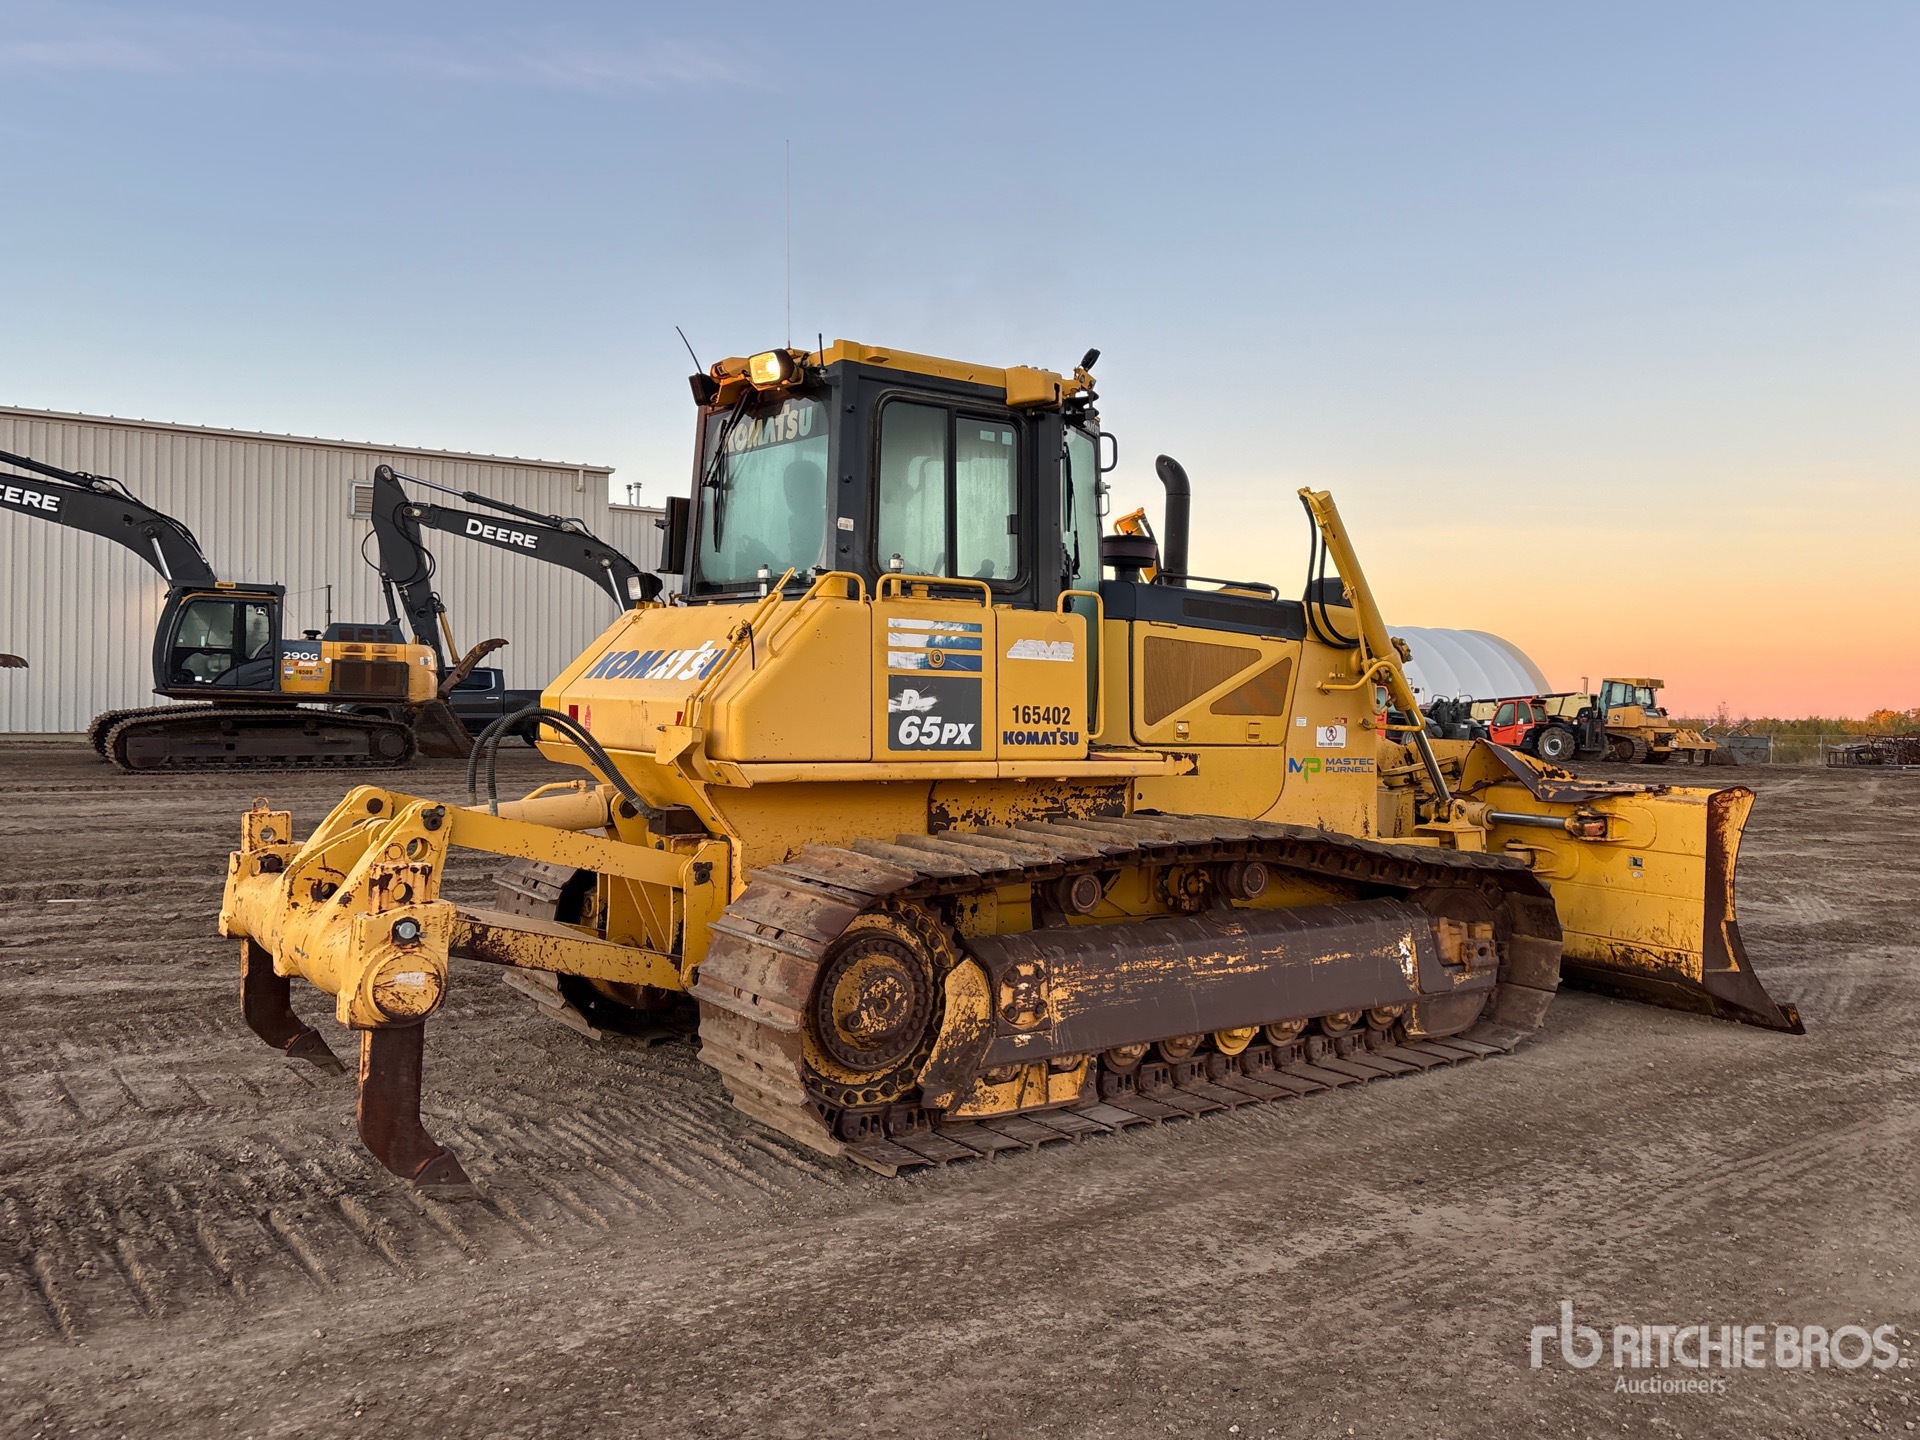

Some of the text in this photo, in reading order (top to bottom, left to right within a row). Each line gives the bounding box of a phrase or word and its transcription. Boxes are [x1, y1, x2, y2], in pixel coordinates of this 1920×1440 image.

[0, 484, 61, 512] ERE
[465, 518, 539, 549] DEERE
[282, 651, 319, 661] 290G
[1012, 704, 1071, 726] 165402
[898, 715, 975, 745] 65PX
[1002, 727, 1079, 746] KOMATSU
